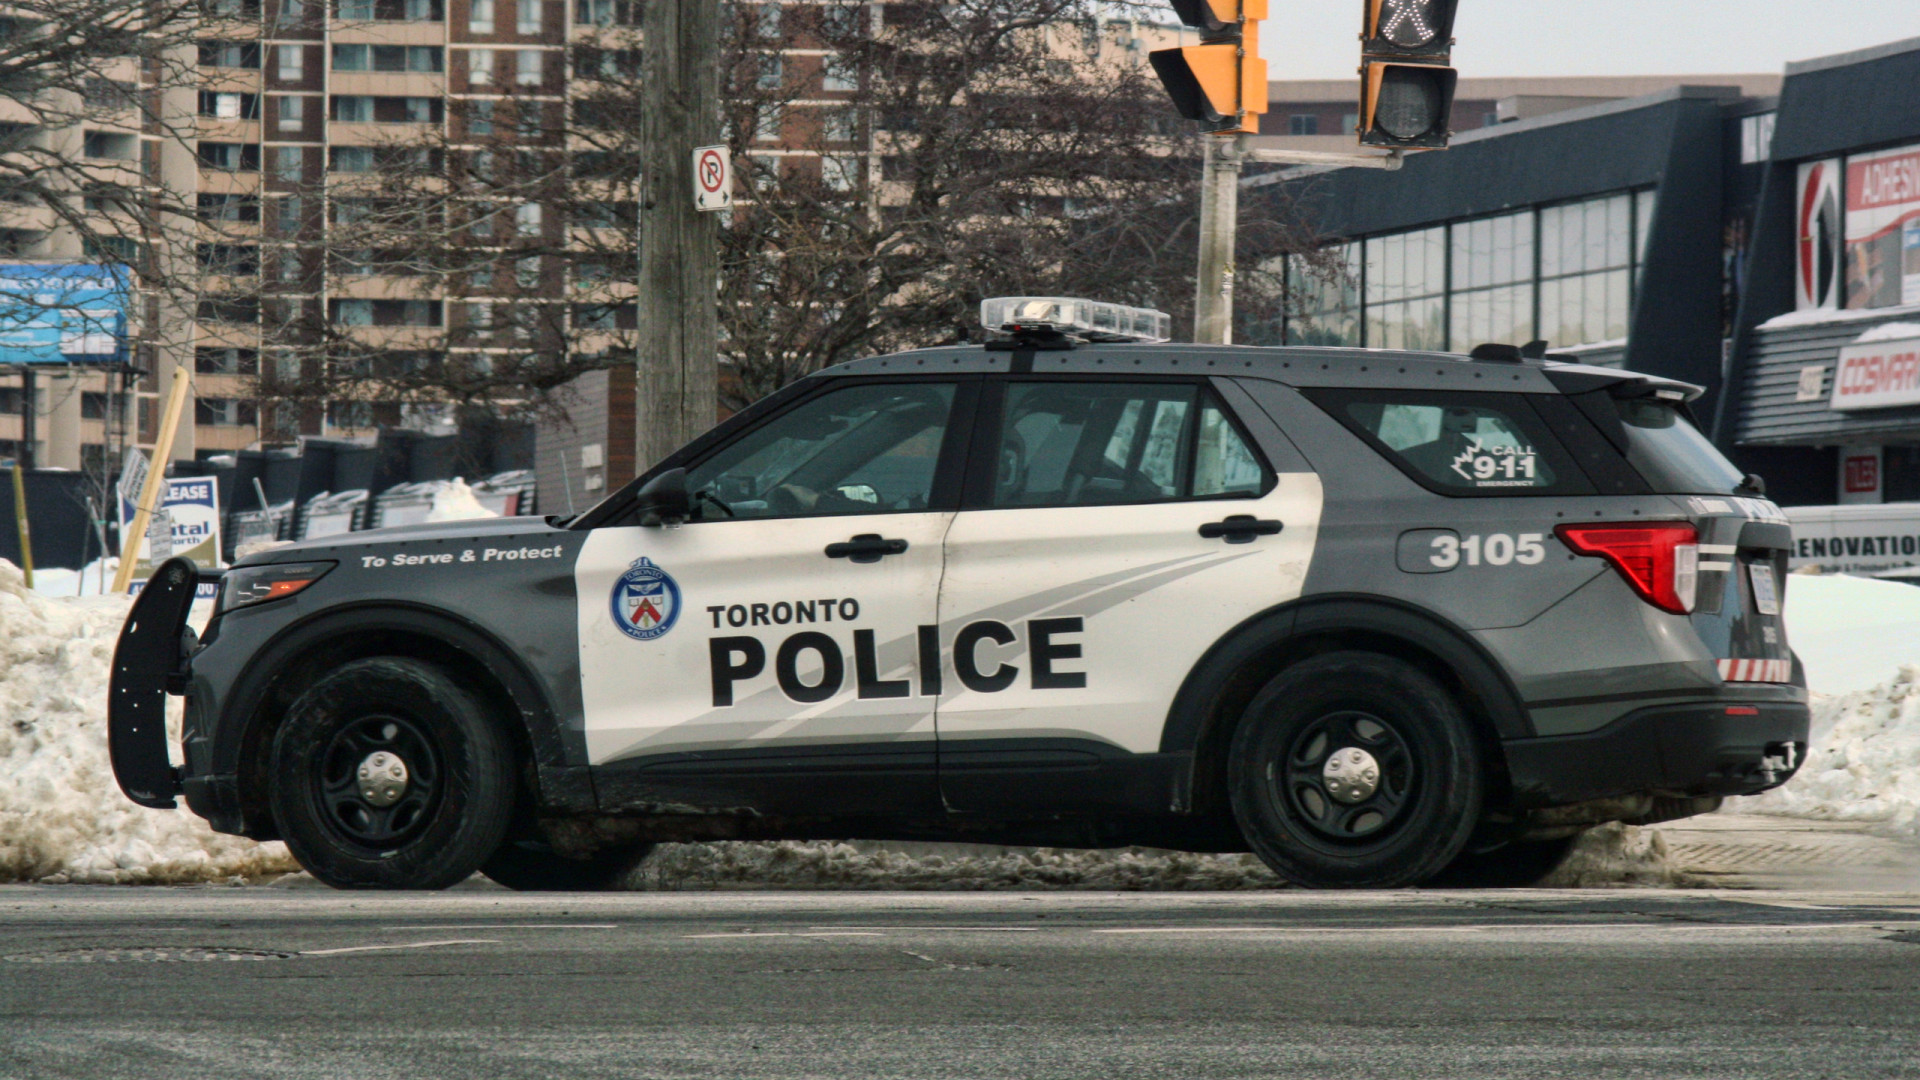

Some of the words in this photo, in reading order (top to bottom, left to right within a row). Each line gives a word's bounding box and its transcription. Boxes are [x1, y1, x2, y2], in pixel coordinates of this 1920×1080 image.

[1840, 352, 1920, 396] COSMAR
[1491, 445, 1537, 456] CALL
[172, 536, 201, 545] orth
[1429, 532, 1546, 568] 3105
[1789, 535, 1920, 558] ENOVATIO
[361, 556, 387, 568] To
[392, 553, 453, 566] Serve
[459, 550, 477, 562] &
[483, 545, 563, 561] Protect
[624, 568, 663, 581] TORONTO
[707, 597, 860, 629] TORONTO
[632, 628, 661, 638] POLICE
[708, 616, 1087, 708] POLICE
